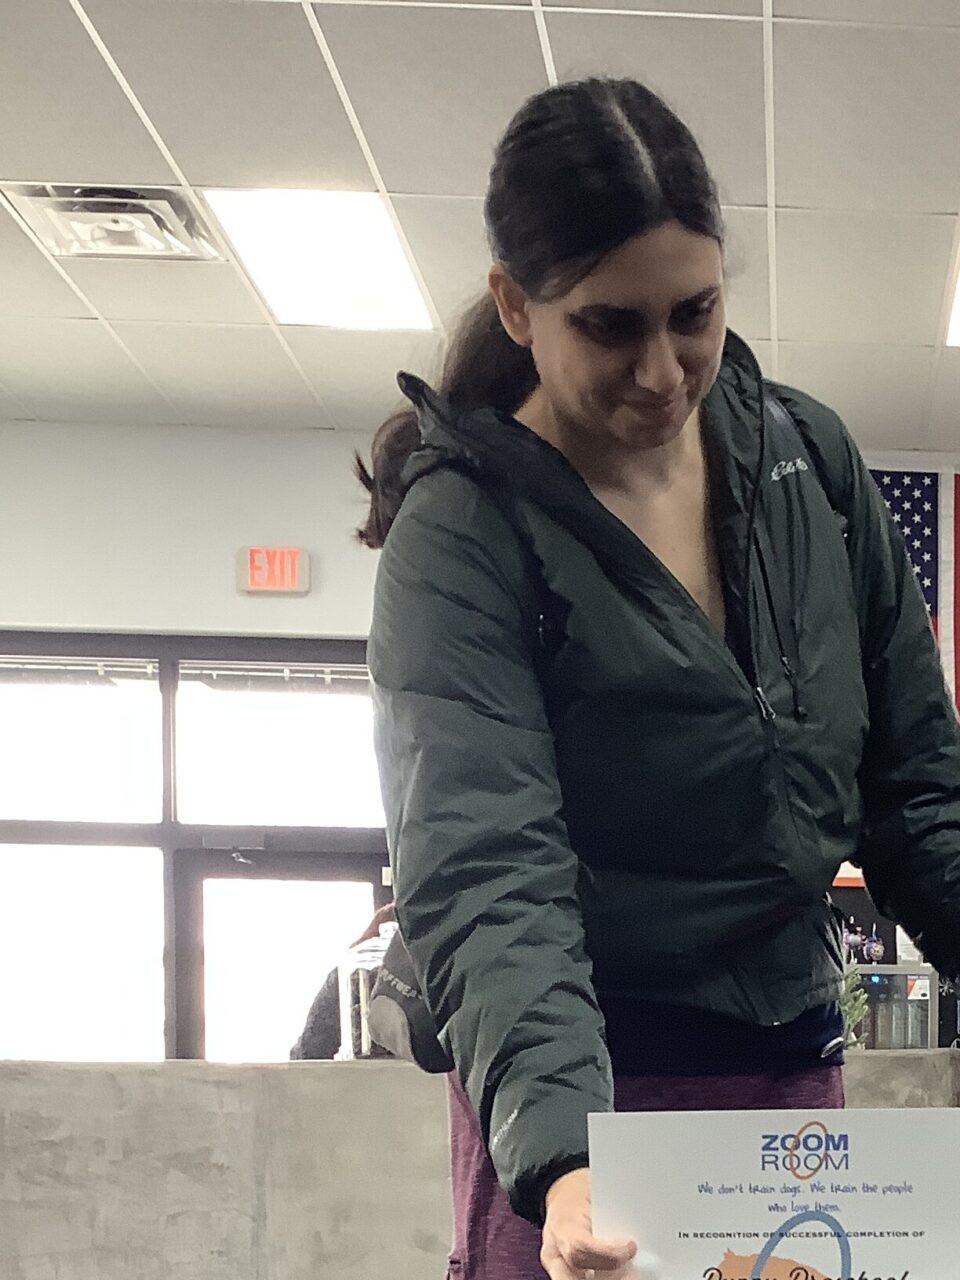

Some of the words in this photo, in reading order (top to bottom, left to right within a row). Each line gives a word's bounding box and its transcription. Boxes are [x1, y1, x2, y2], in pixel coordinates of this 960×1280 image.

[249, 547, 300, 589] EXIT
[762, 1133, 849, 1151] ZOOM
[762, 1153, 849, 1171] ROOM
[698, 1182, 713, 1194] We
[718, 1184, 744, 1194] don't
[810, 1181, 826, 1194] We
[862, 1182, 878, 1193] the
[882, 1181, 913, 1196] people
[768, 1203, 787, 1213] who
[791, 1201, 810, 1212] love
[693, 1231, 759, 1239] RECOGNITION
[763, 1231, 775, 1239] OF
[779, 1231, 842, 1239] SUCCESSFUL
[846, 1231, 909, 1239] COMPLETION
